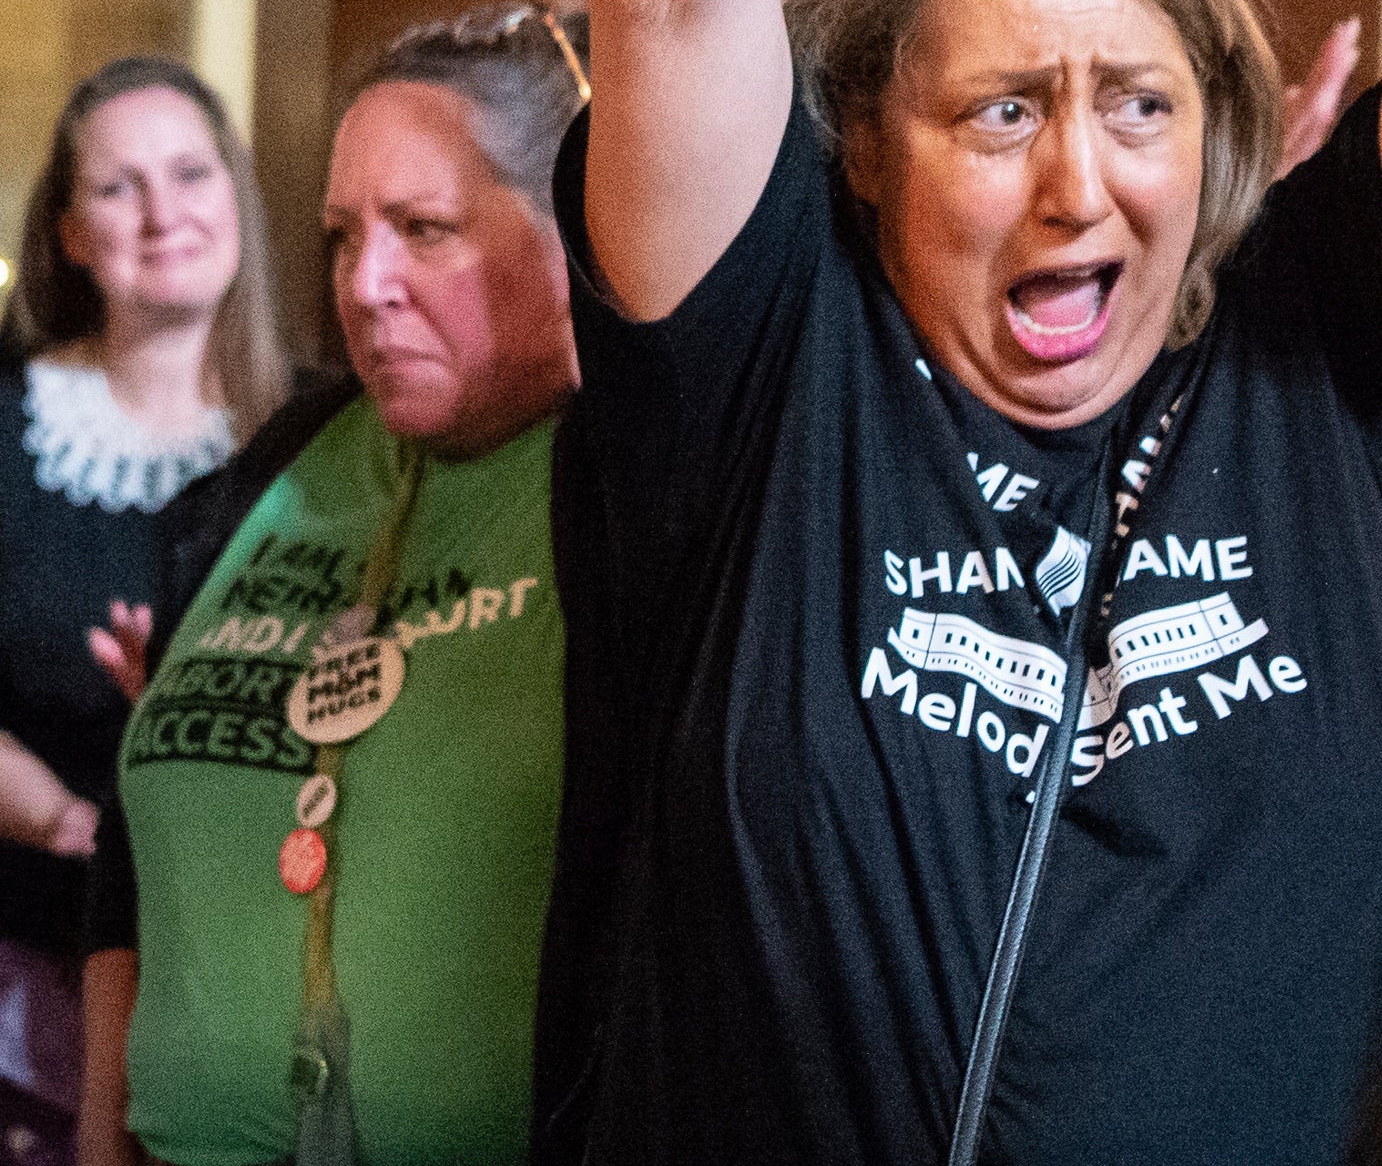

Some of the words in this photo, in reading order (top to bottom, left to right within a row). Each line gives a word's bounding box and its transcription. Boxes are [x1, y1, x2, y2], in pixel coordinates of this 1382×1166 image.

[1122, 533, 1254, 582] AME
[305, 642, 382, 679] FREE
[307, 687, 382, 726] HUGS
[861, 646, 1050, 804] Melod
[1198, 654, 1308, 722] Me
